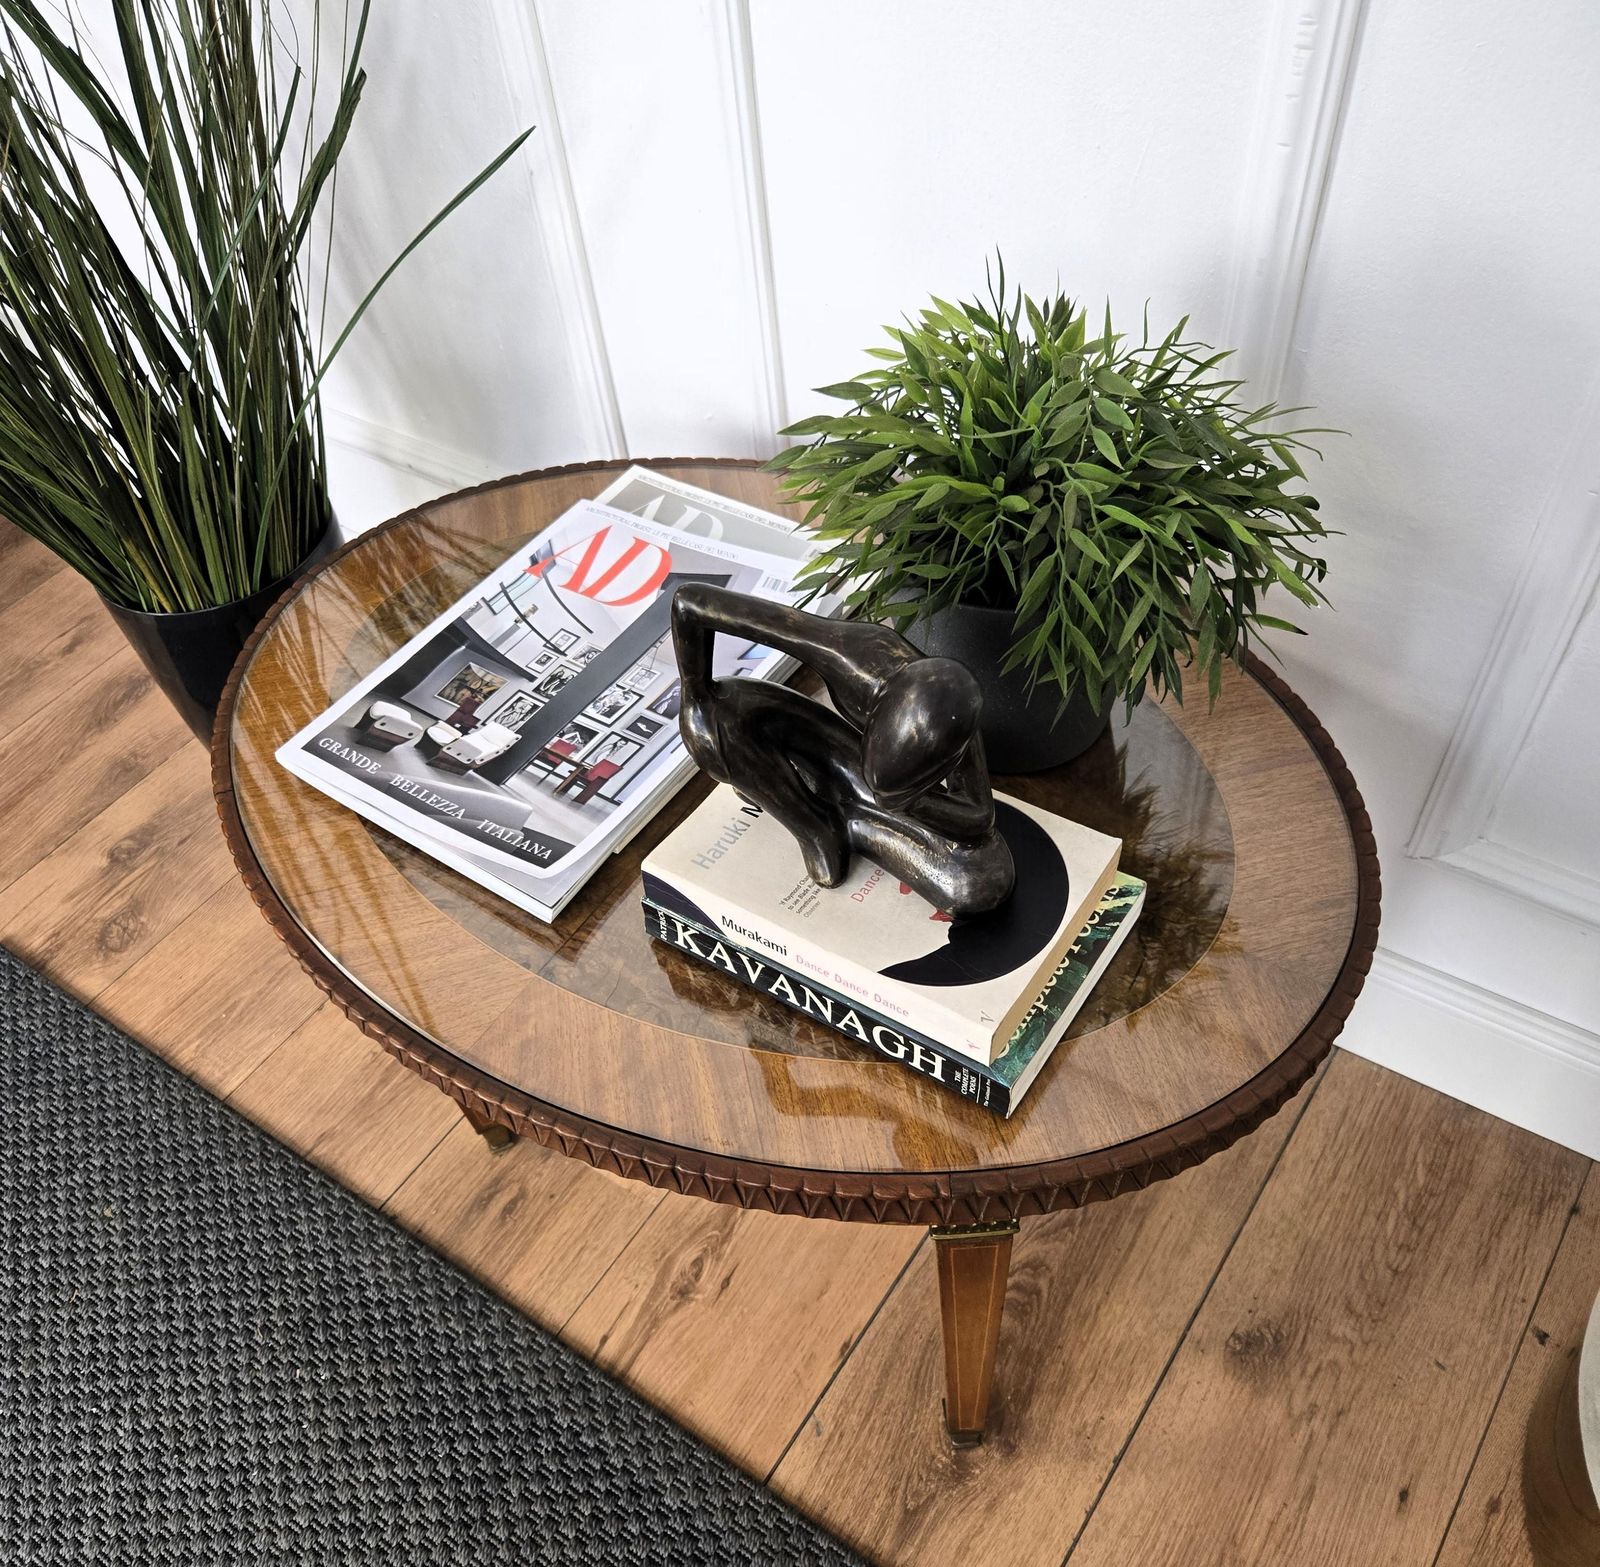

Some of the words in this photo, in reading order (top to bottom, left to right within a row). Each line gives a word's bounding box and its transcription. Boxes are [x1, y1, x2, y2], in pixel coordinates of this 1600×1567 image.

[522, 525, 673, 607] AD
[318, 737, 382, 775] GRANDE
[389, 775, 466, 820] BELLEZZA
[476, 819, 553, 860] ITALIANA
[690, 817, 752, 870] Haruki
[850, 869, 885, 903] Dance
[721, 915, 788, 957] Murakami
[795, 953, 830, 979] Dance
[834, 973, 869, 997] Dance
[873, 993, 910, 1018] Dance
[671, 919, 946, 1083] KAVANAGH
[961, 1067, 969, 1095] COMPLETE
[969, 1075, 977, 1094] POEMS
